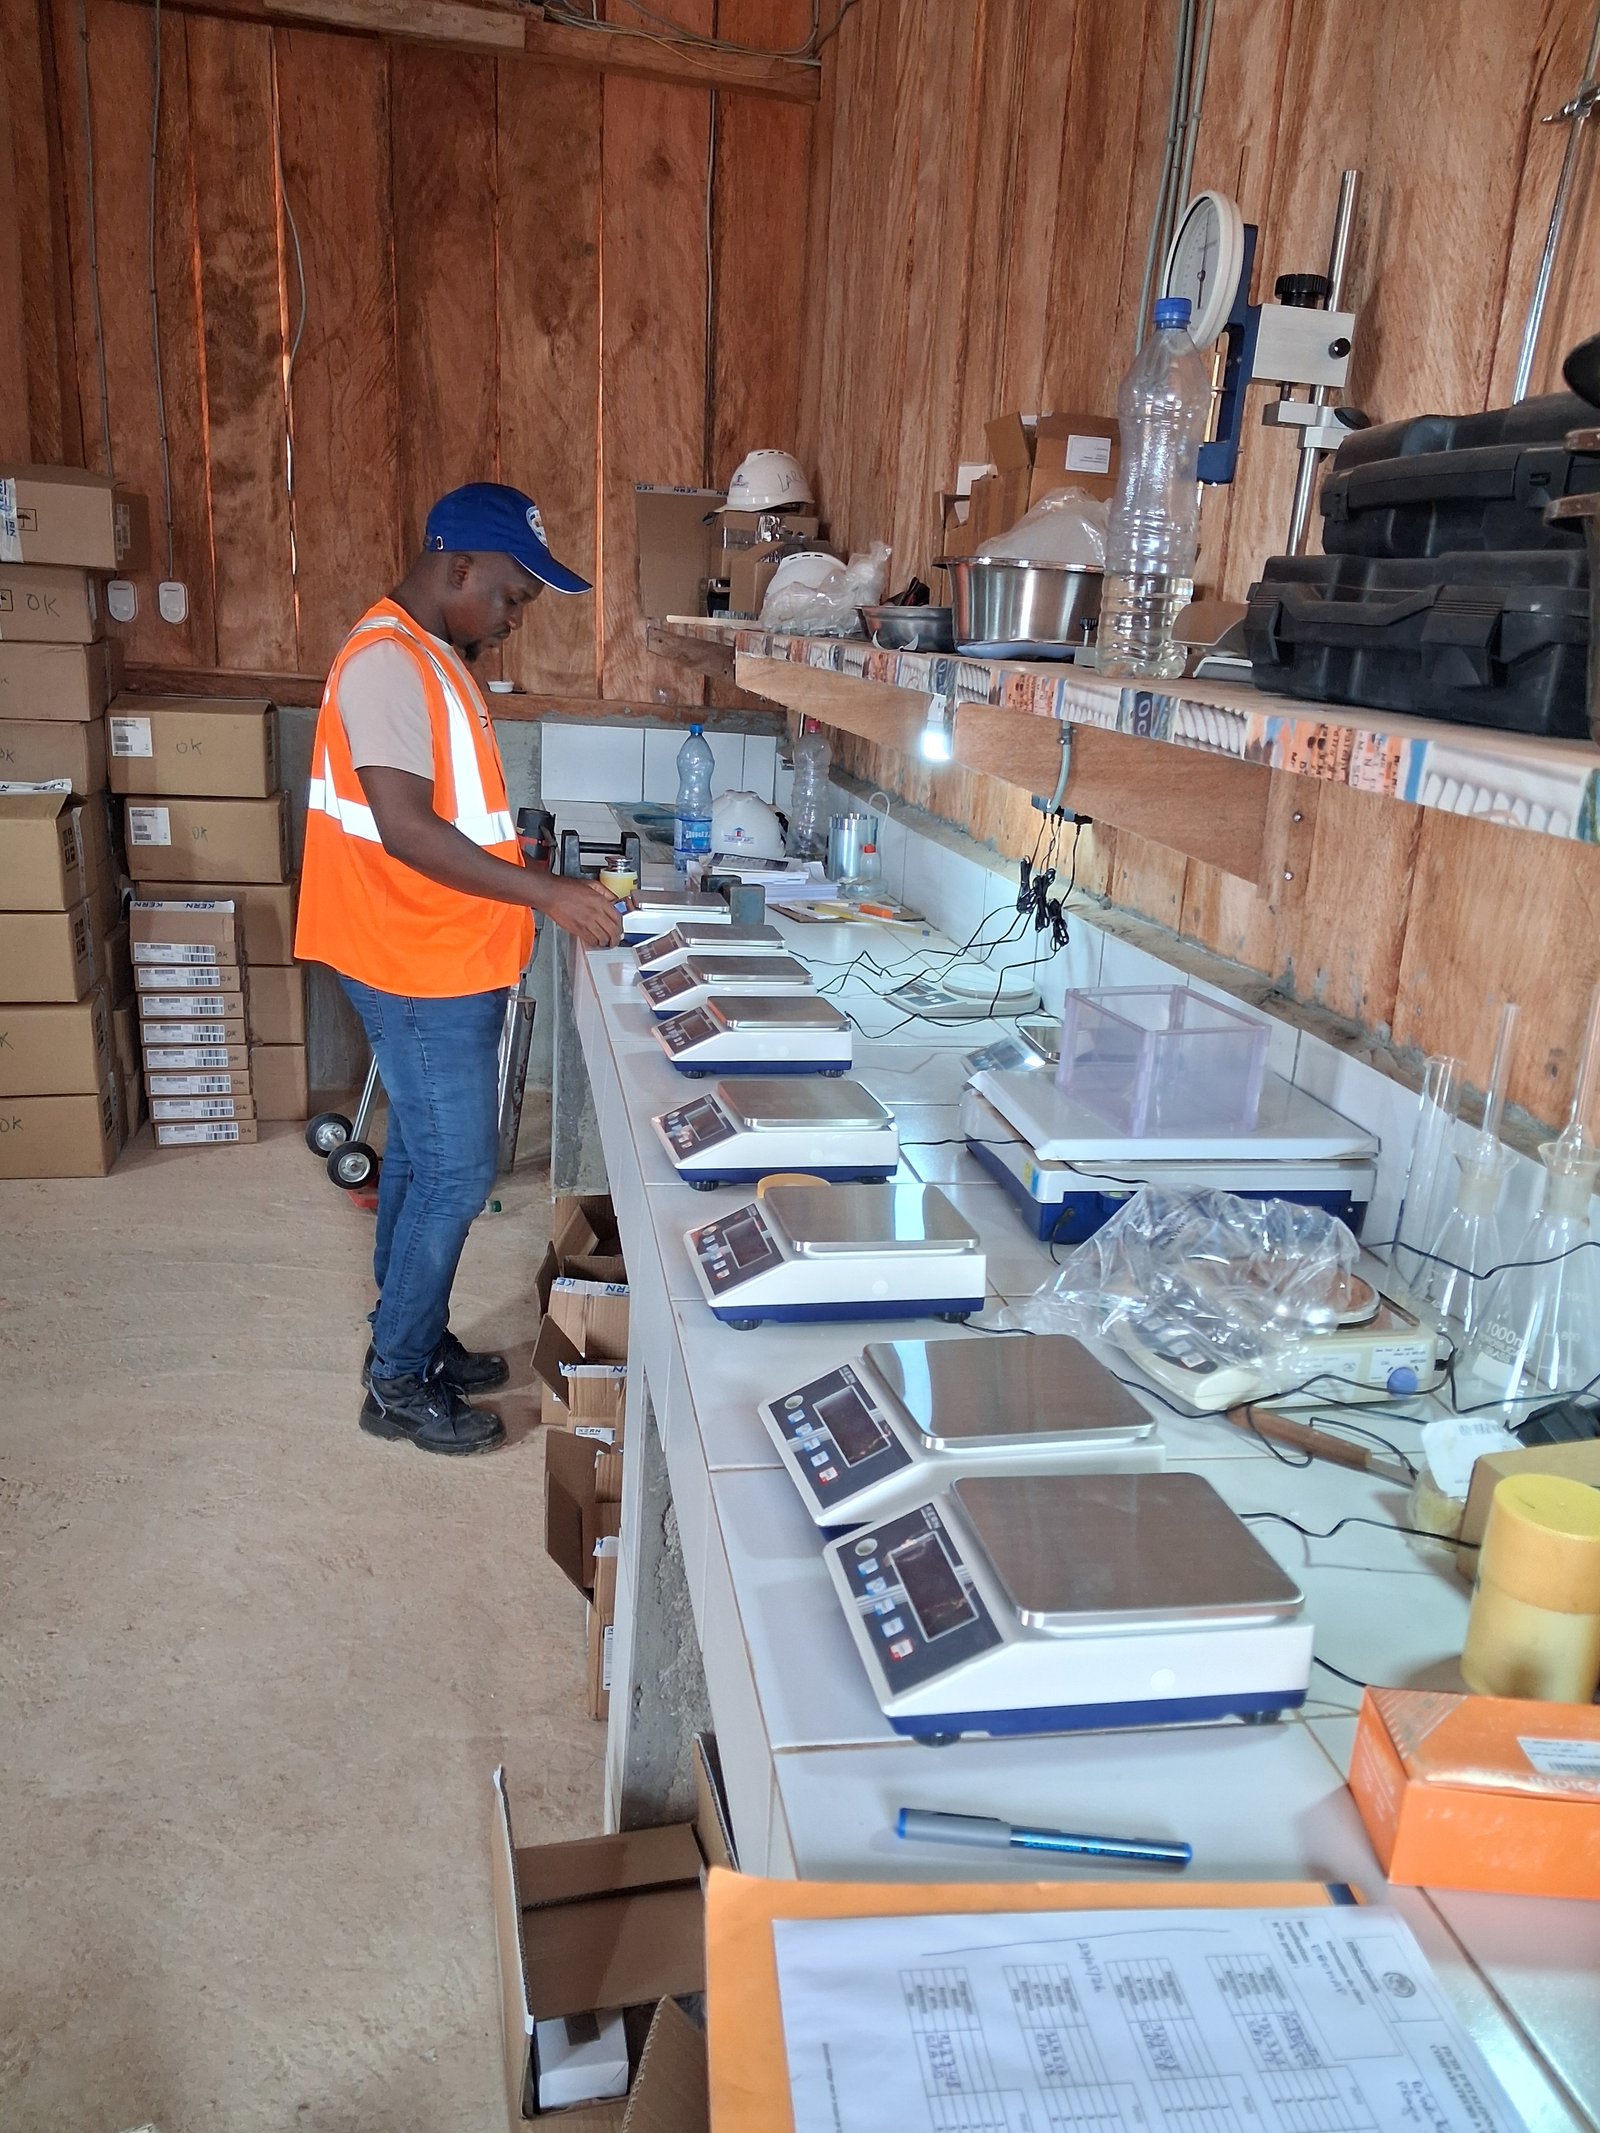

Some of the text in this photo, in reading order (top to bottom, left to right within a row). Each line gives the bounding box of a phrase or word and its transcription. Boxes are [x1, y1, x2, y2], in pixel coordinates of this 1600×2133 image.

[26, 593, 60, 617] OK
[176, 739, 202, 754] OK
[192, 827, 208, 841] OK
[0, 1116, 23, 1132] OK
[1486, 1320, 1524, 1348] 1000m
